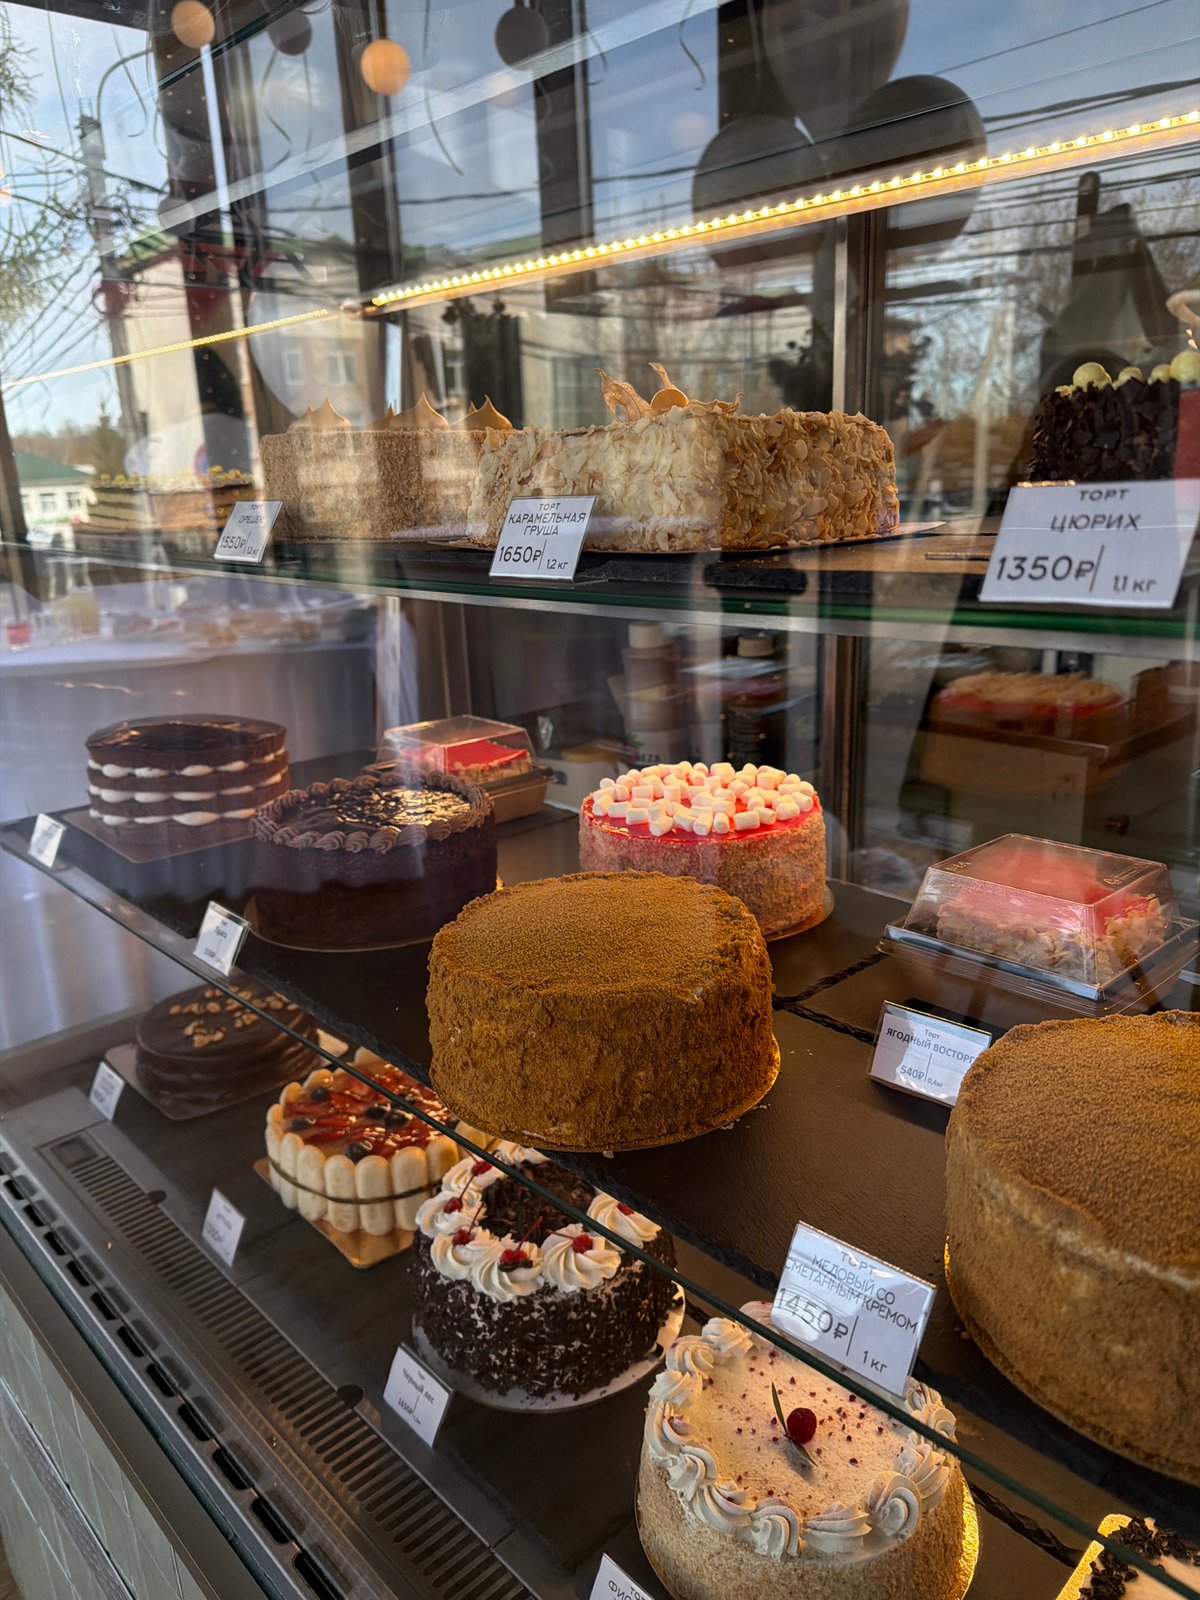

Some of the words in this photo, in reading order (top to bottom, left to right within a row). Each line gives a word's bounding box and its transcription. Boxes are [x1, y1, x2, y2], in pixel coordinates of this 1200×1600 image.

[1079, 488, 1130, 501] ТОРТ
[539, 502, 562, 511] ТОРТ
[508, 512, 587, 524] КАРАМЕЛЬНАЯ
[1050, 513, 1141, 532] ЦЮРИХ
[523, 525, 559, 536] ГРУША
[925, 1029, 941, 1040] Торт
[886, 1027, 932, 1050] ЯГОДНЫЙ
[932, 1043, 976, 1064] ВОСТОРГ
[812, 1254, 876, 1296] МЕДОВЫЙ
[875, 1287, 896, 1306] СО
[784, 1257, 861, 1303] СМЕТАННЫМ
[860, 1296, 919, 1335] КРЕМОМ
[862, 1350, 869, 1365] 1
[870, 1358, 888, 1373] кг
